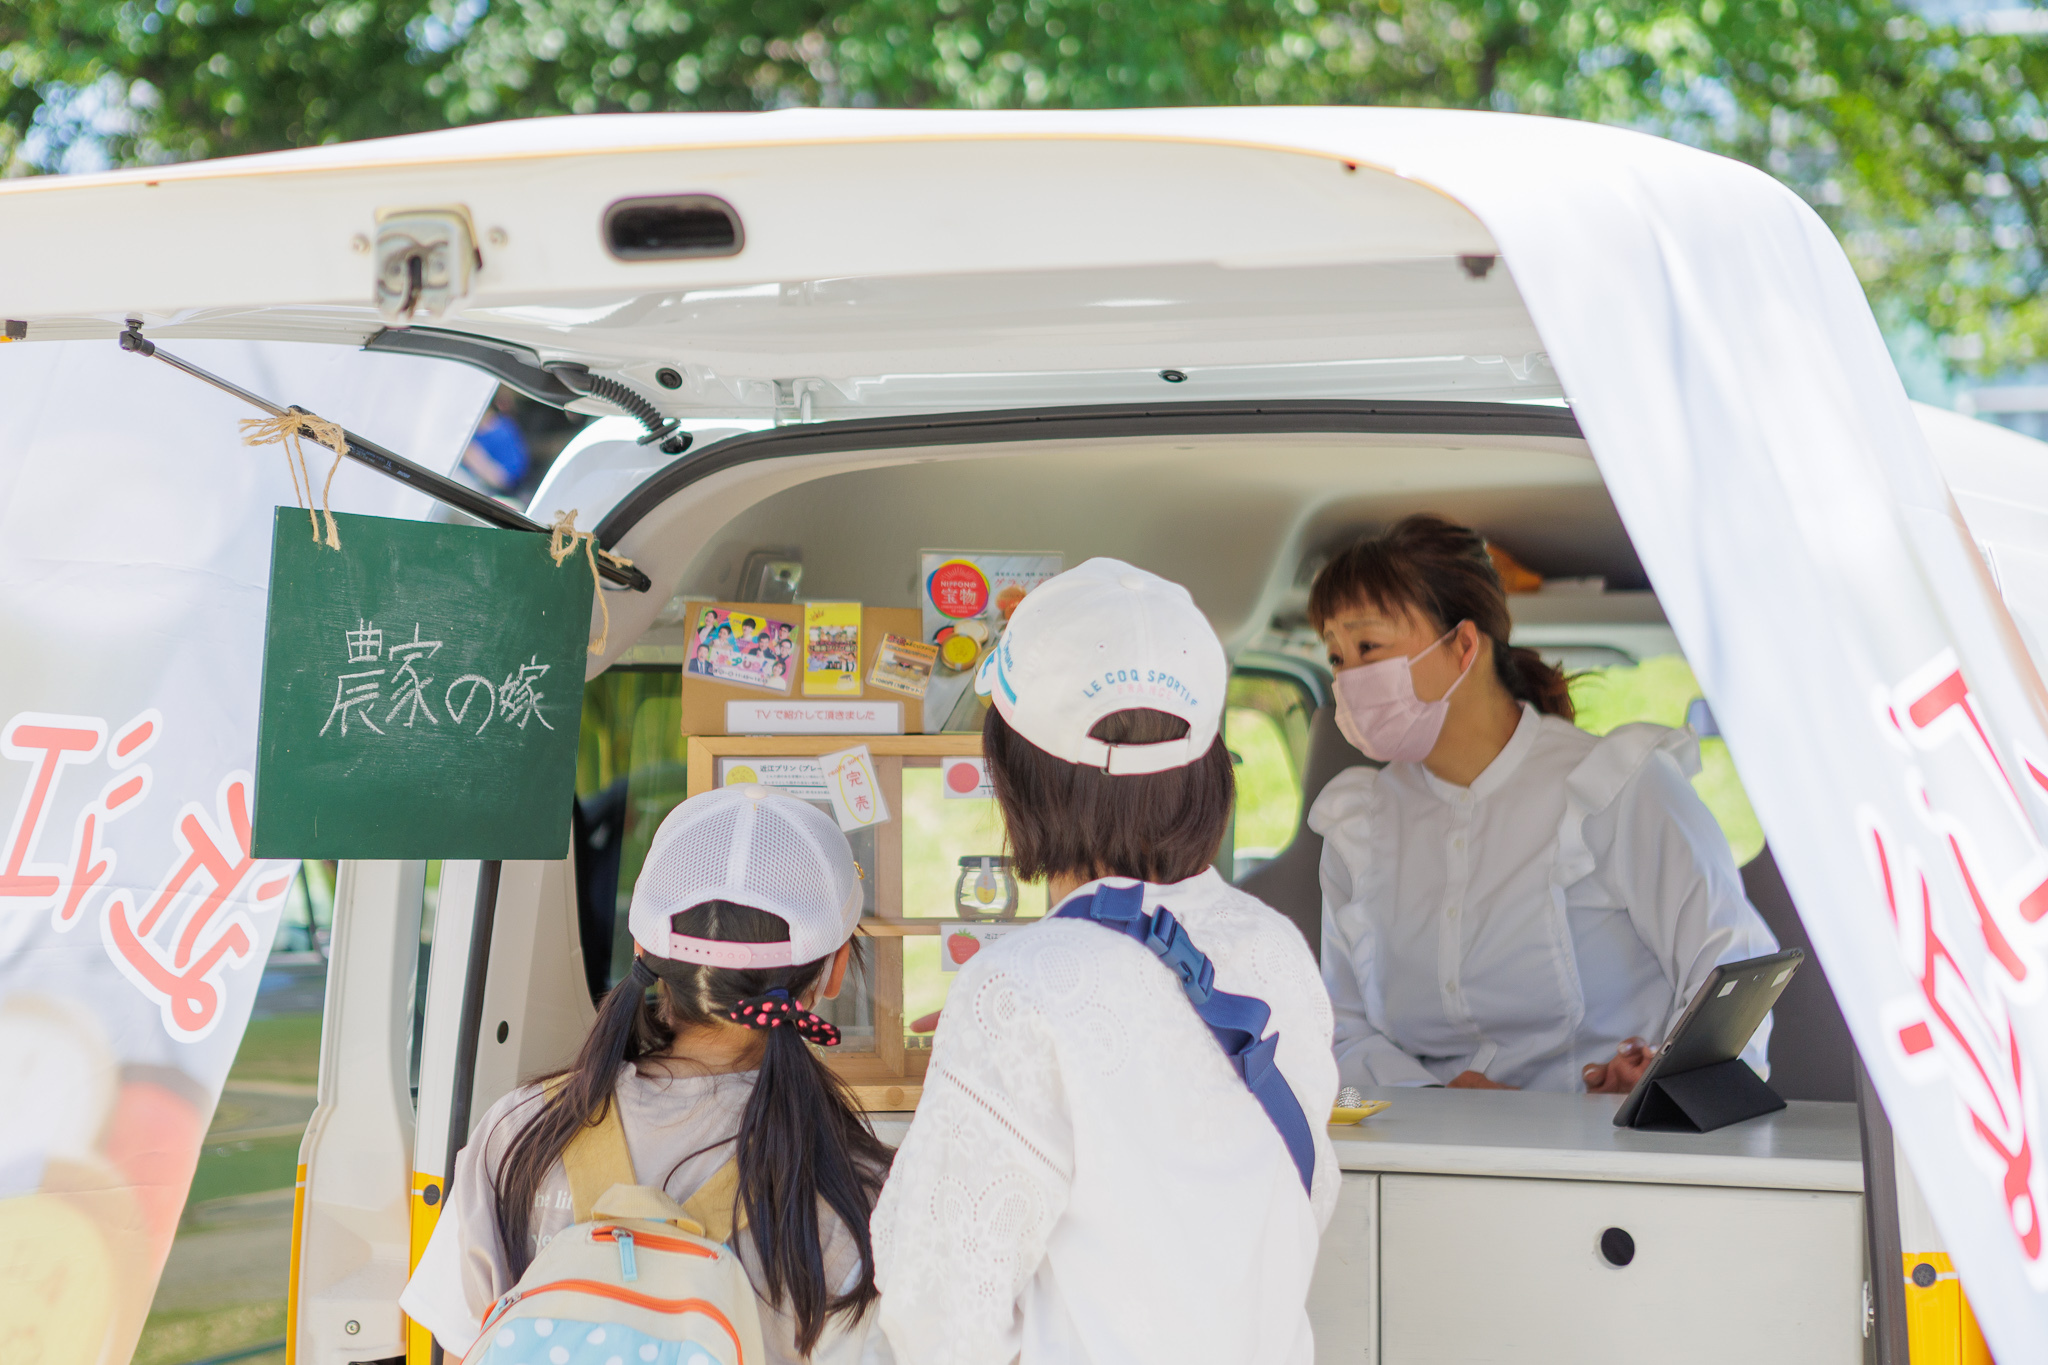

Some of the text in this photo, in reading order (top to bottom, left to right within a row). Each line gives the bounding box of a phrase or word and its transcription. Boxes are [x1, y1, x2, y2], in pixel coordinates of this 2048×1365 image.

[941, 588, 977, 605] 宝物
[318, 617, 554, 736] 農家の嫁
[1083, 669, 1198, 706] LE COQ SPORTIF
[1117, 683, 1174, 701] FRANCE
[828, 753, 865, 777] really sorry
[846, 770, 870, 812] 完売
